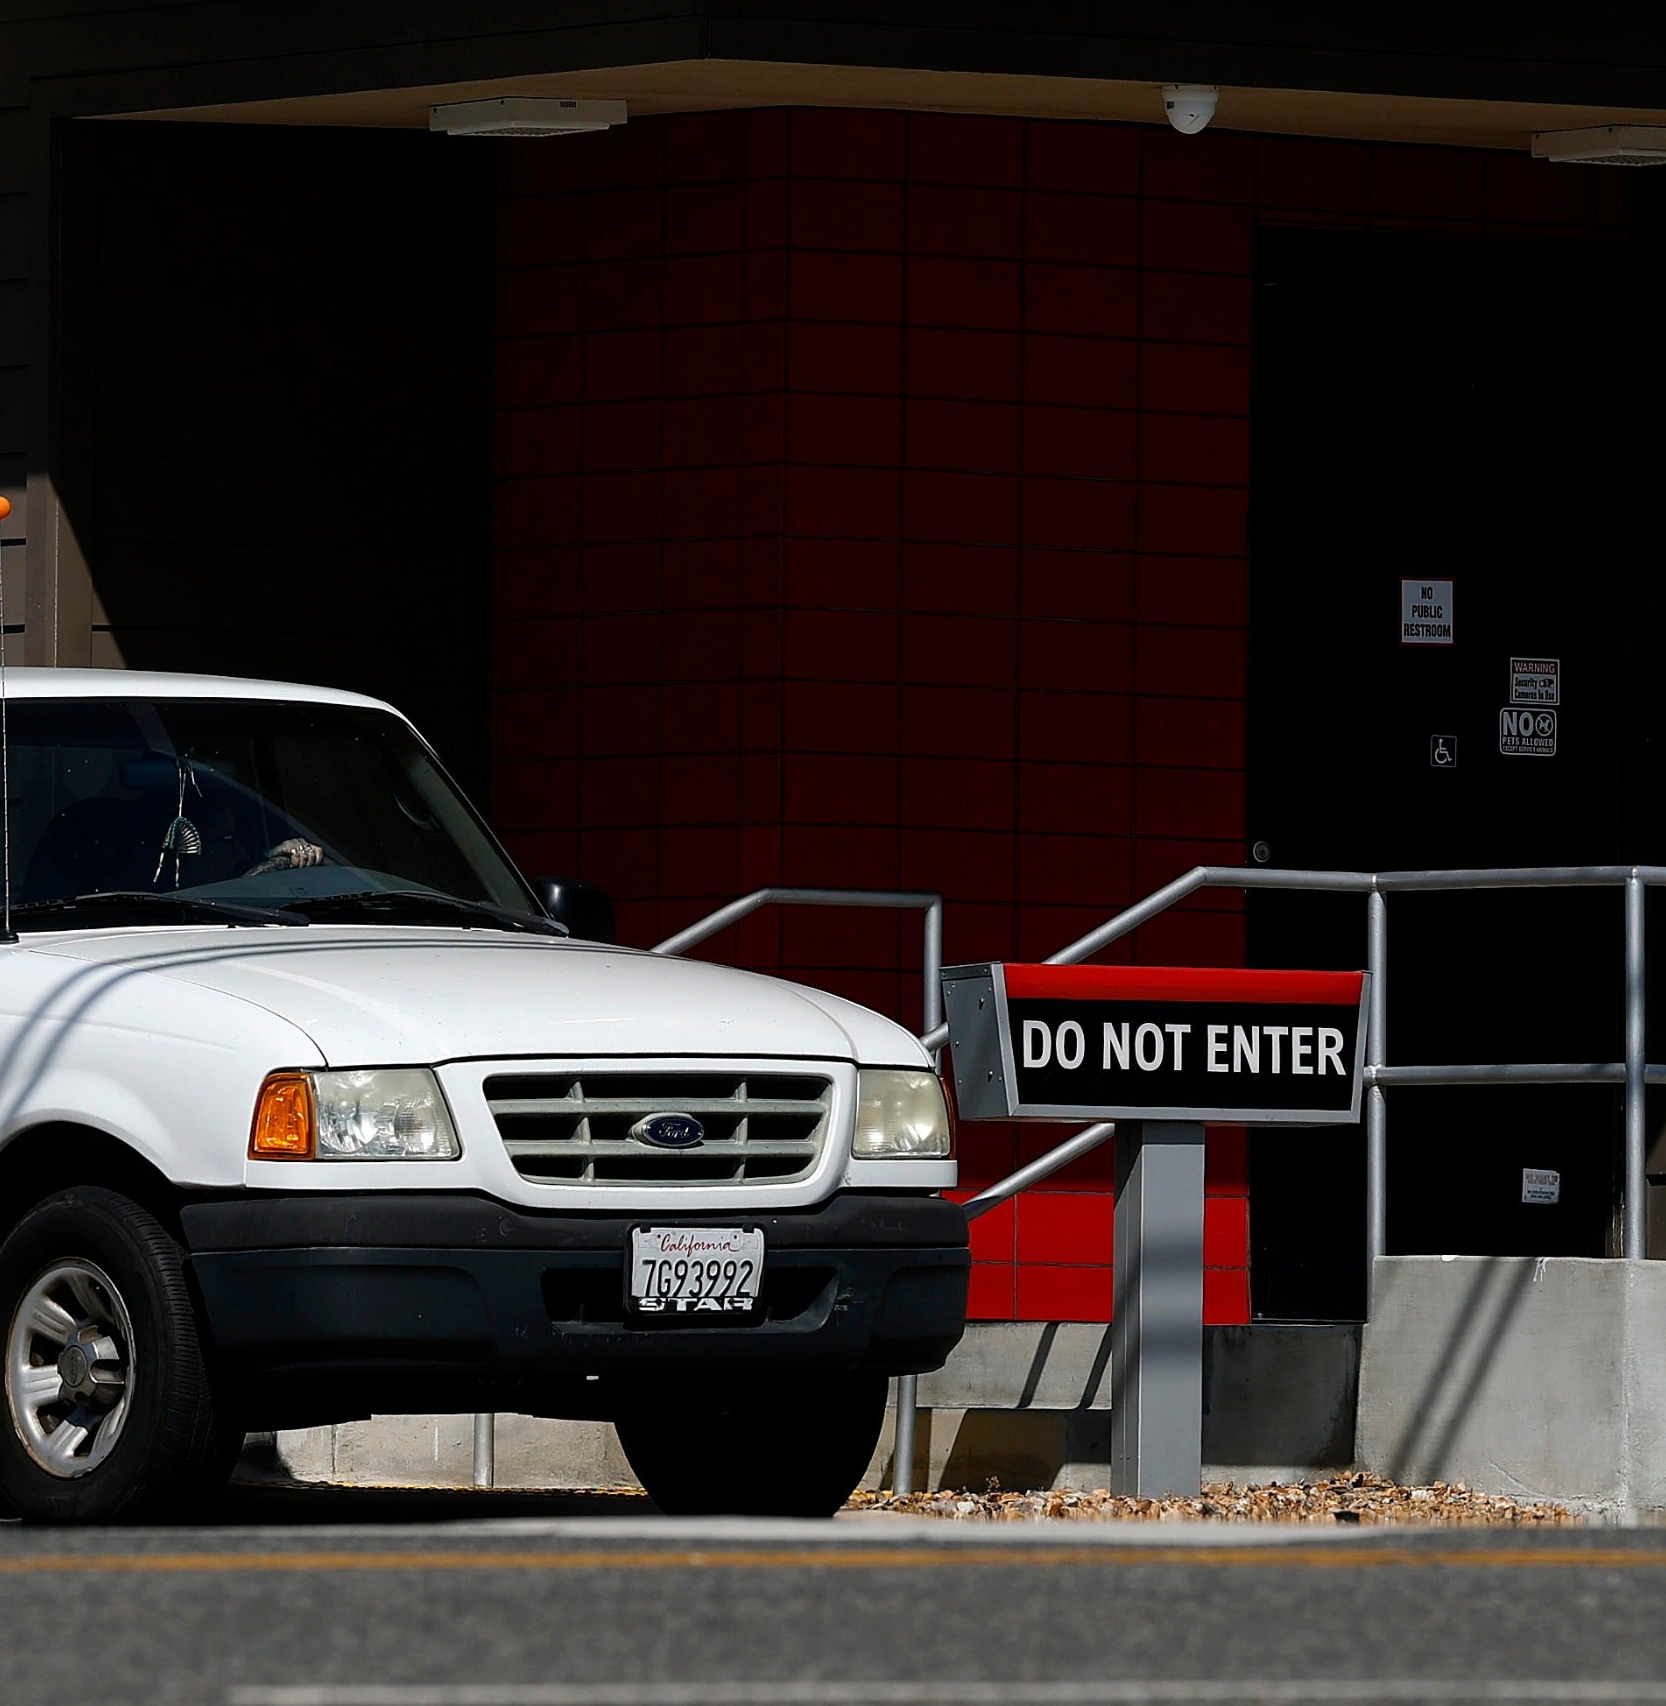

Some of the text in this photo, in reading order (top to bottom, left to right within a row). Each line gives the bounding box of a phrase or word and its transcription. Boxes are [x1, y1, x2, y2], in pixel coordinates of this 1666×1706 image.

[1421, 586, 1433, 600] NO
[1412, 604, 1443, 619] PUBLIC
[1404, 623, 1451, 638] RESTROOM
[1514, 661, 1556, 674] WARNING
[1515, 677, 1537, 689] Security
[1502, 711, 1534, 736] NO
[1502, 737, 1554, 747] PETS ALLOWED
[1022, 1019, 1347, 1076] DO NOT ENTER
[658, 1122, 690, 1139] Ford
[660, 1234, 741, 1257] California
[642, 1259, 754, 1298] 7G93992
